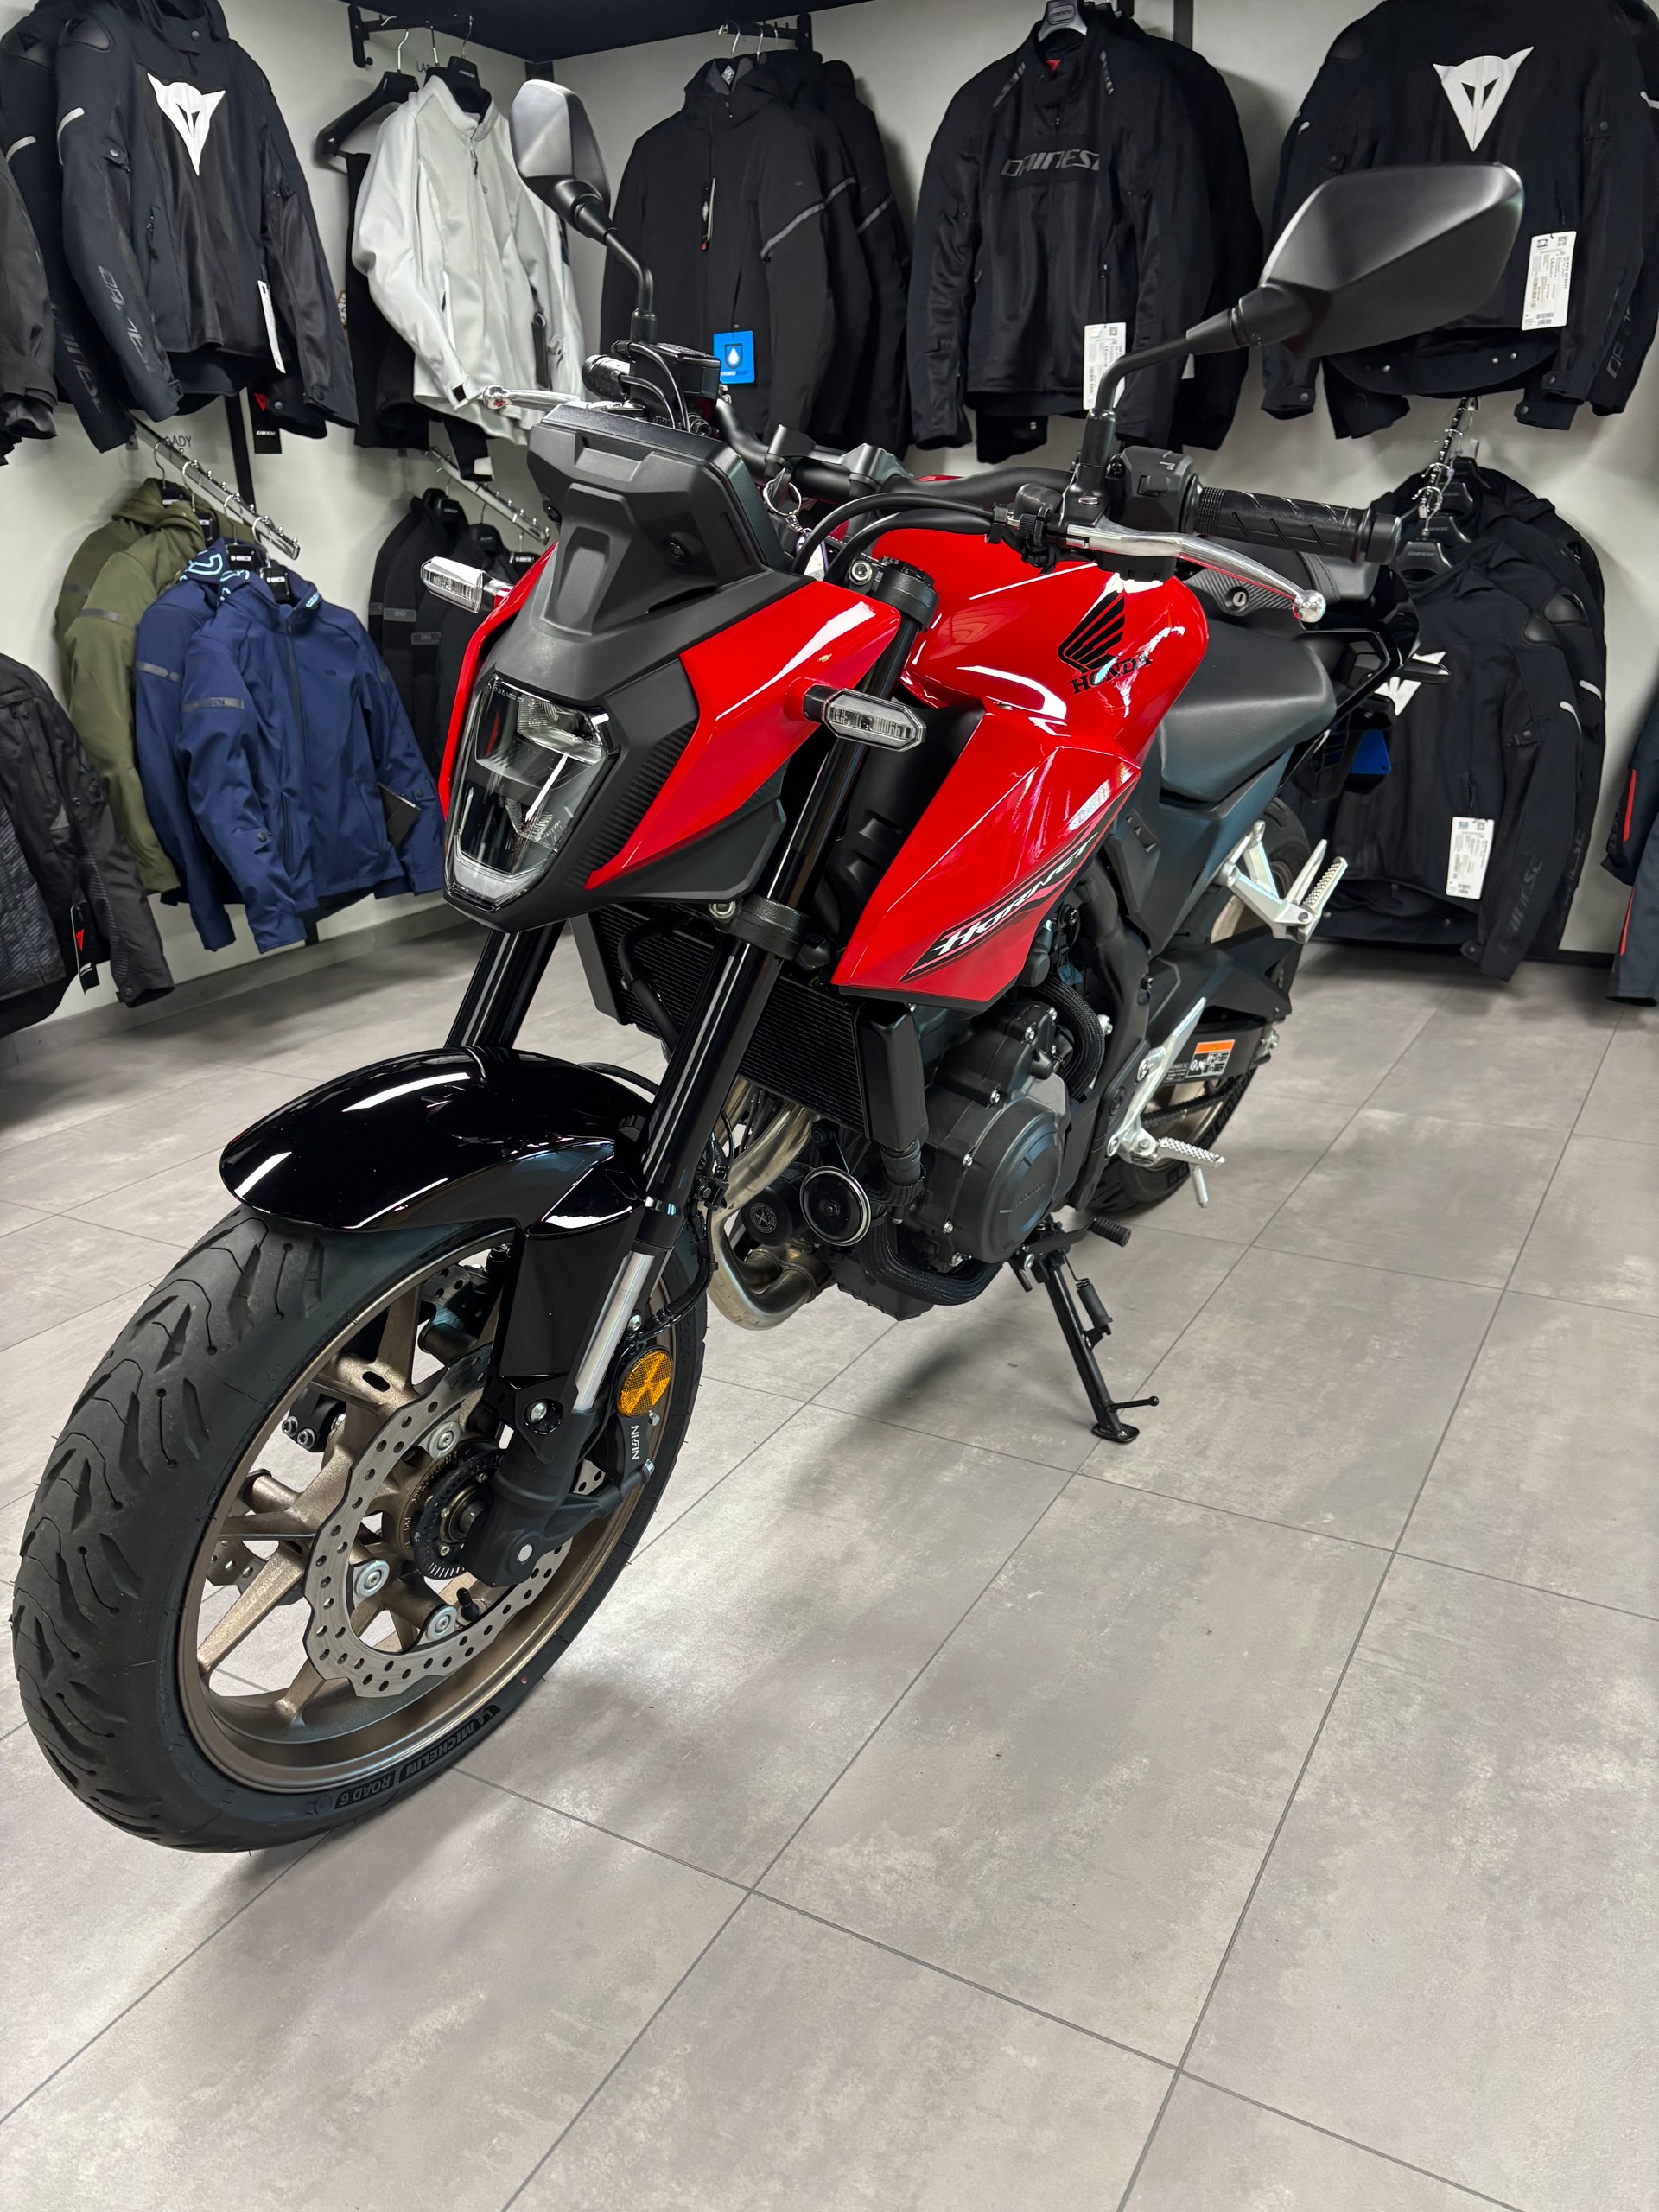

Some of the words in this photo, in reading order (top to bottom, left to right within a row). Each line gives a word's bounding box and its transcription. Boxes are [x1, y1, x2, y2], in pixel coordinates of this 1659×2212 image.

[168, 435, 192, 447] ADY
[1070, 652, 1154, 694] HONDA
[630, 1425, 640, 1460] NISSIN
[405, 1719, 477, 1777] MICHELIN
[340, 1791, 349, 1804] 6
[353, 1777, 391, 1800] ROAD
